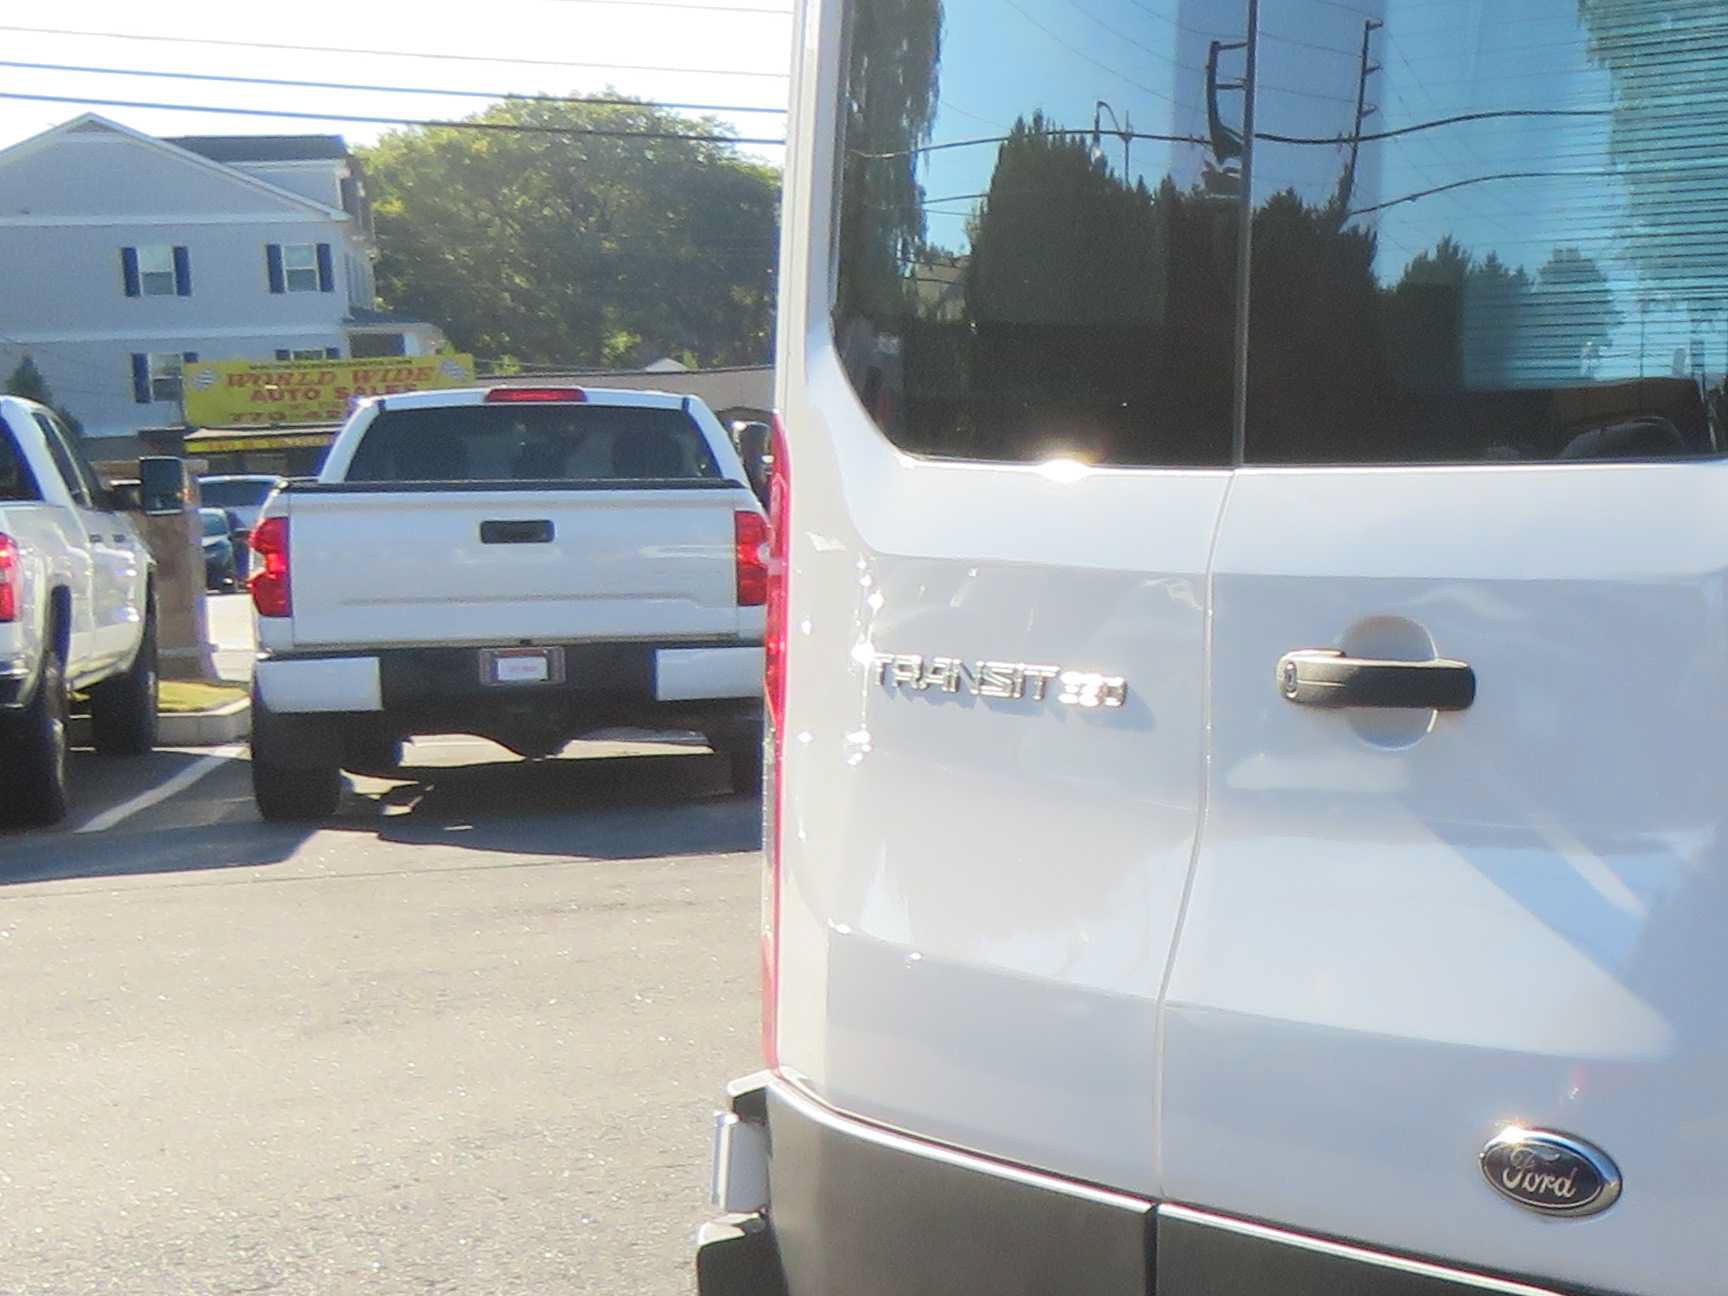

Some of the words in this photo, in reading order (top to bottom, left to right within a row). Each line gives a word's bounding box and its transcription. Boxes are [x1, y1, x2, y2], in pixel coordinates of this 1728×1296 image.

[225, 370, 337, 387] WORLD
[352, 366, 434, 384] WIDE
[251, 388, 320, 402] AUTO
[873, 653, 1060, 701] TRANSIT
[1503, 1146, 1577, 1198] Ford
